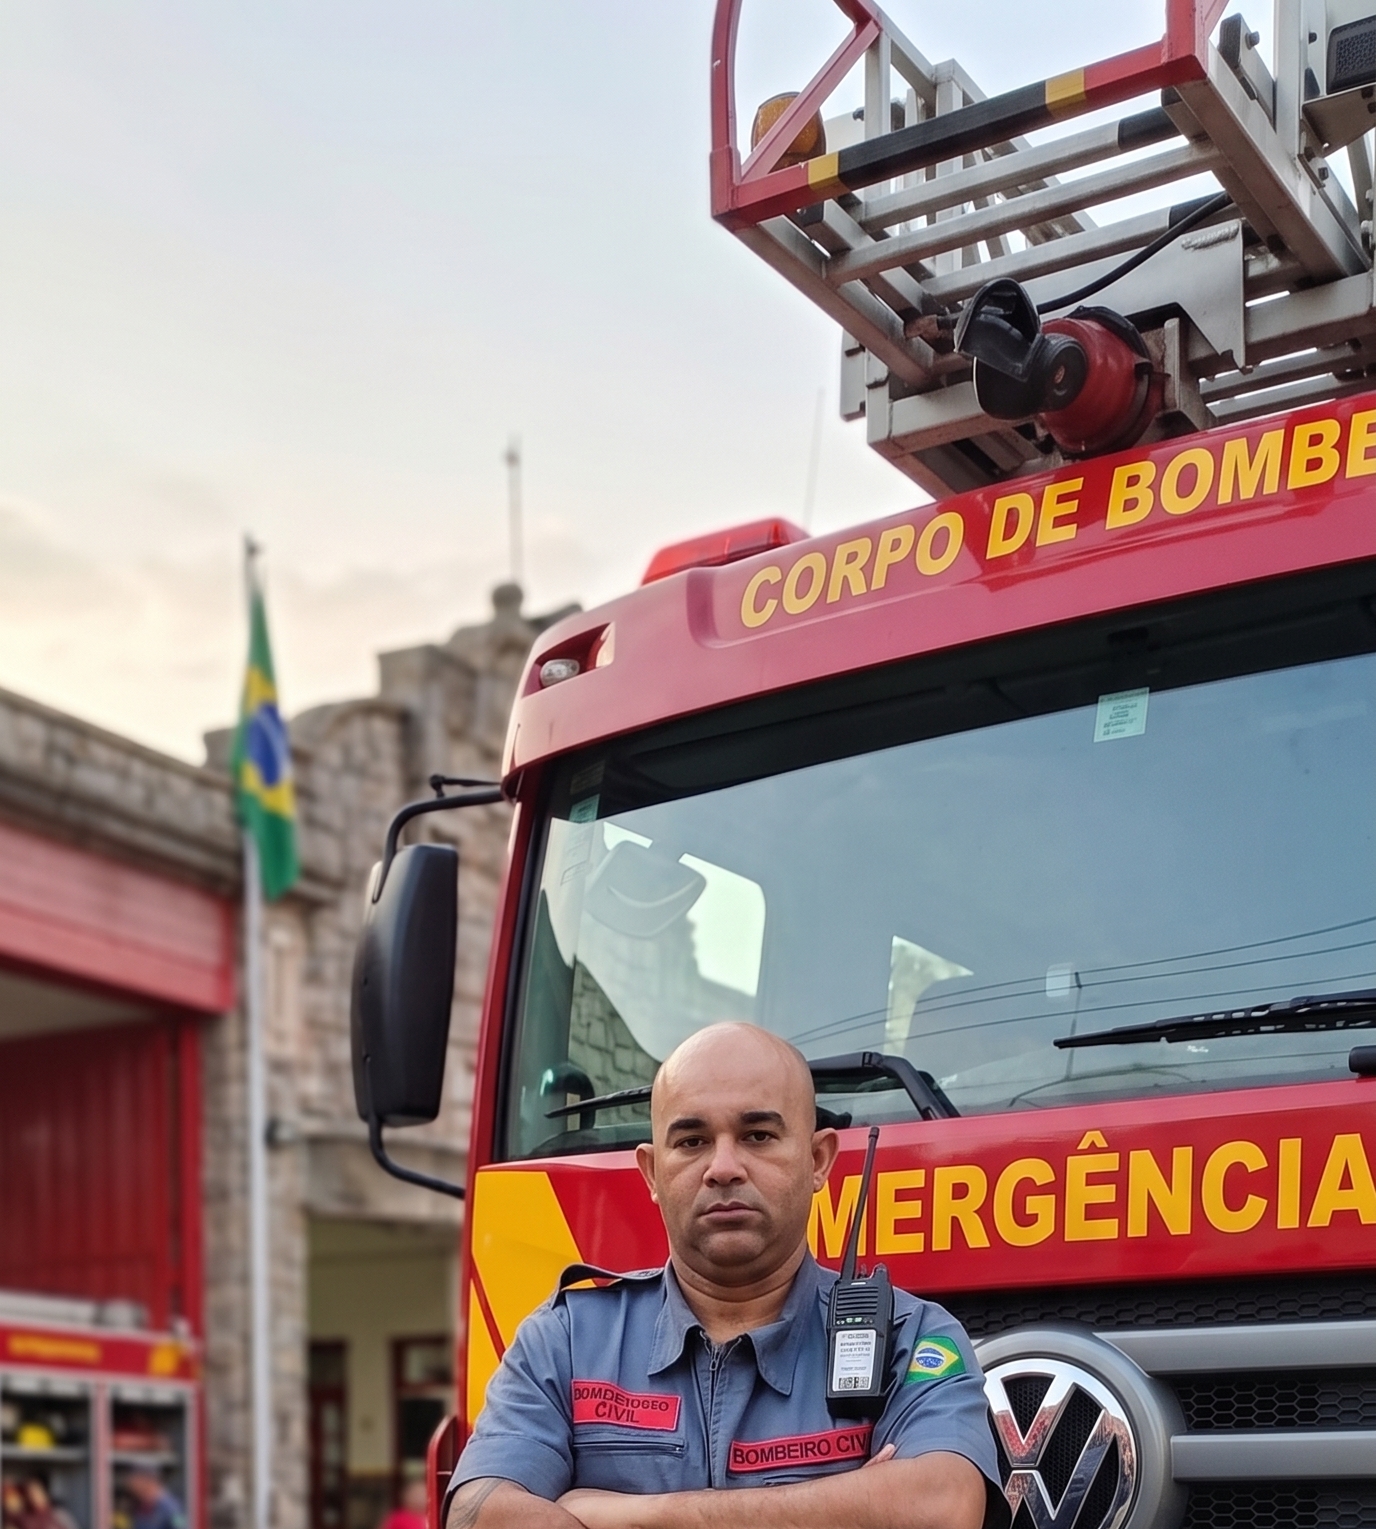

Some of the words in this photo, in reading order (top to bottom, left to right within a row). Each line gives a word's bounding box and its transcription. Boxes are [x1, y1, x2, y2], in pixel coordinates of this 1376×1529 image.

[740, 512, 964, 628] CORPO
[985, 477, 1084, 559] DE
[1105, 408, 1376, 531] BOMBE
[806, 1130, 1376, 1260] MERGÊNCIA
[595, 1401, 640, 1423] CIVIL
[733, 1438, 832, 1465] BOMBEIRO
[836, 1431, 869, 1452] CIV
